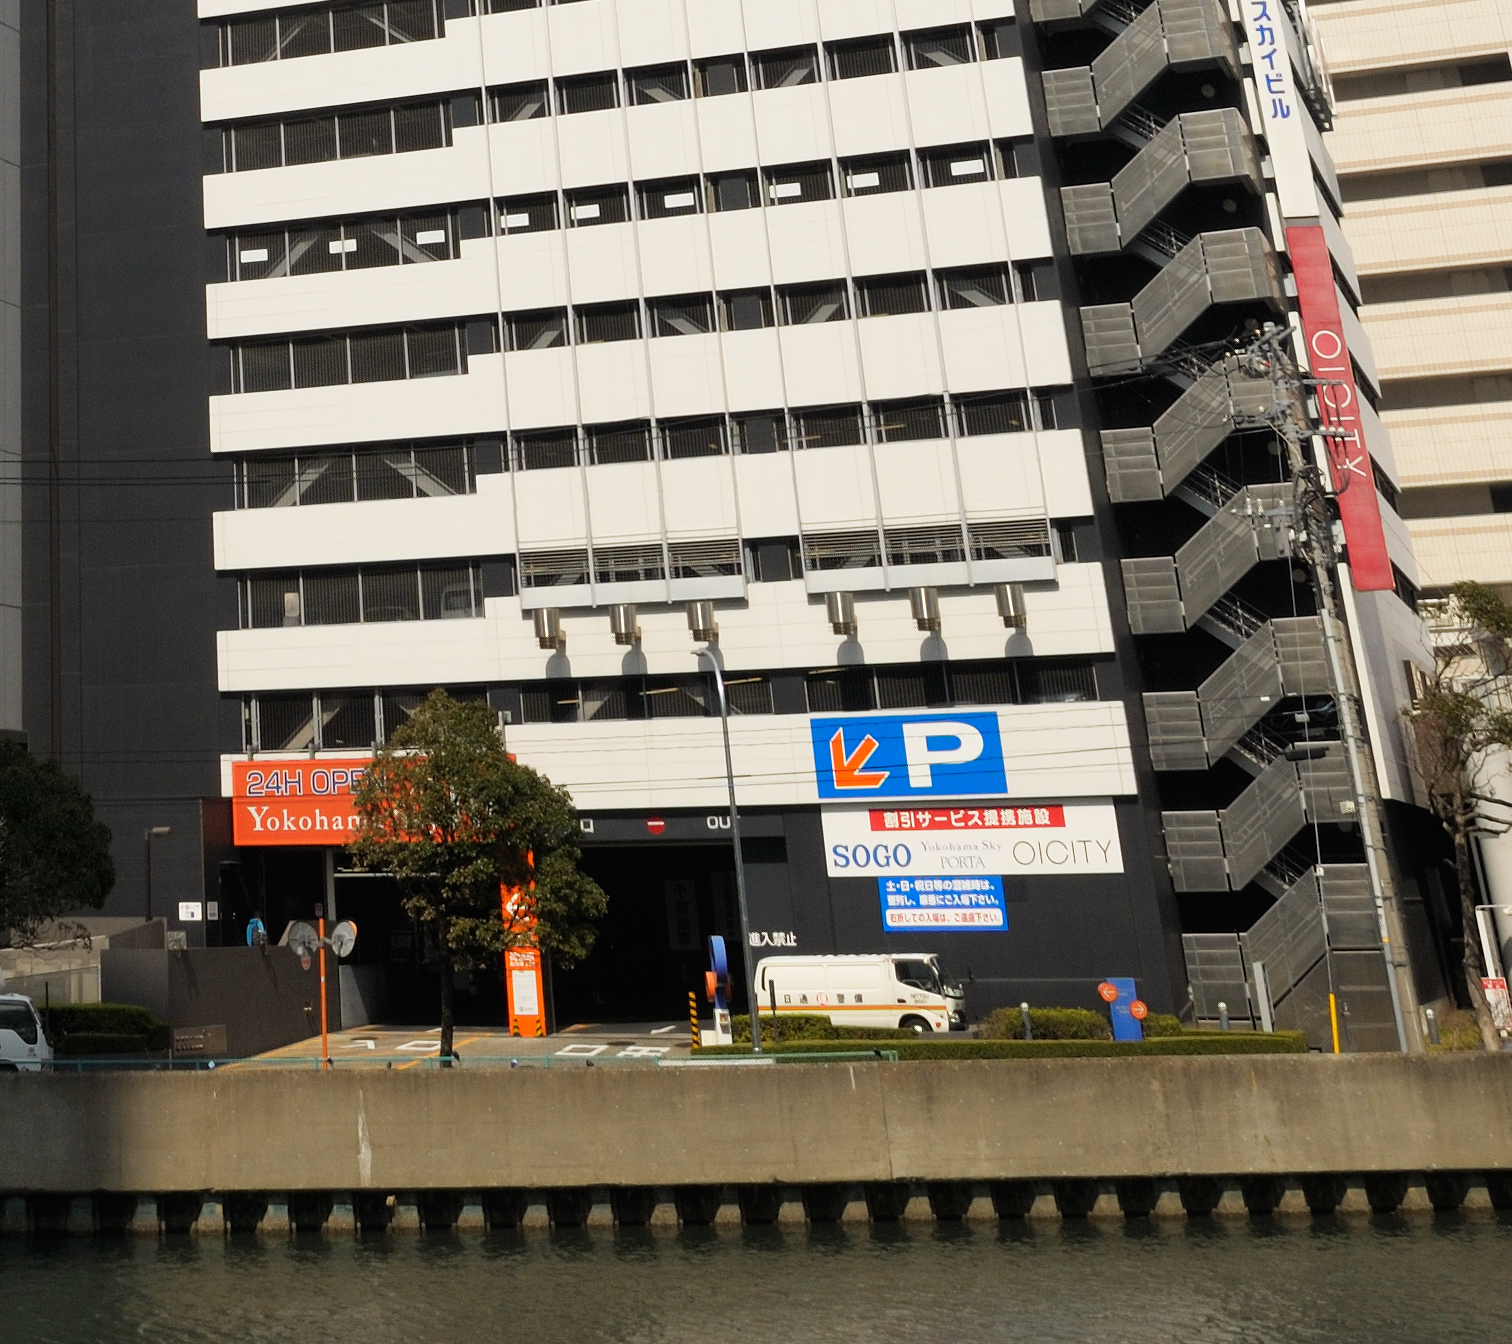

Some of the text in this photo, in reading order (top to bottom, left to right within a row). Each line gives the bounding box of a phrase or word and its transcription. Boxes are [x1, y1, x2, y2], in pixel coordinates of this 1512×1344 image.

[1250, 0, 1292, 120] スカイビル
[902, 721, 985, 788] P
[245, 769, 304, 798] 24H
[246, 806, 368, 832] Yokoha
[706, 815, 741, 830] OU
[883, 809, 1051, 829] 割引サービス提携施設
[832, 842, 912, 869] SOGO
[920, 839, 1003, 853] Yokohama Sky
[1012, 839, 1112, 866] OICITY
[940, 855, 986, 870] PORTA
[747, 930, 797, 948] 進入禁止
